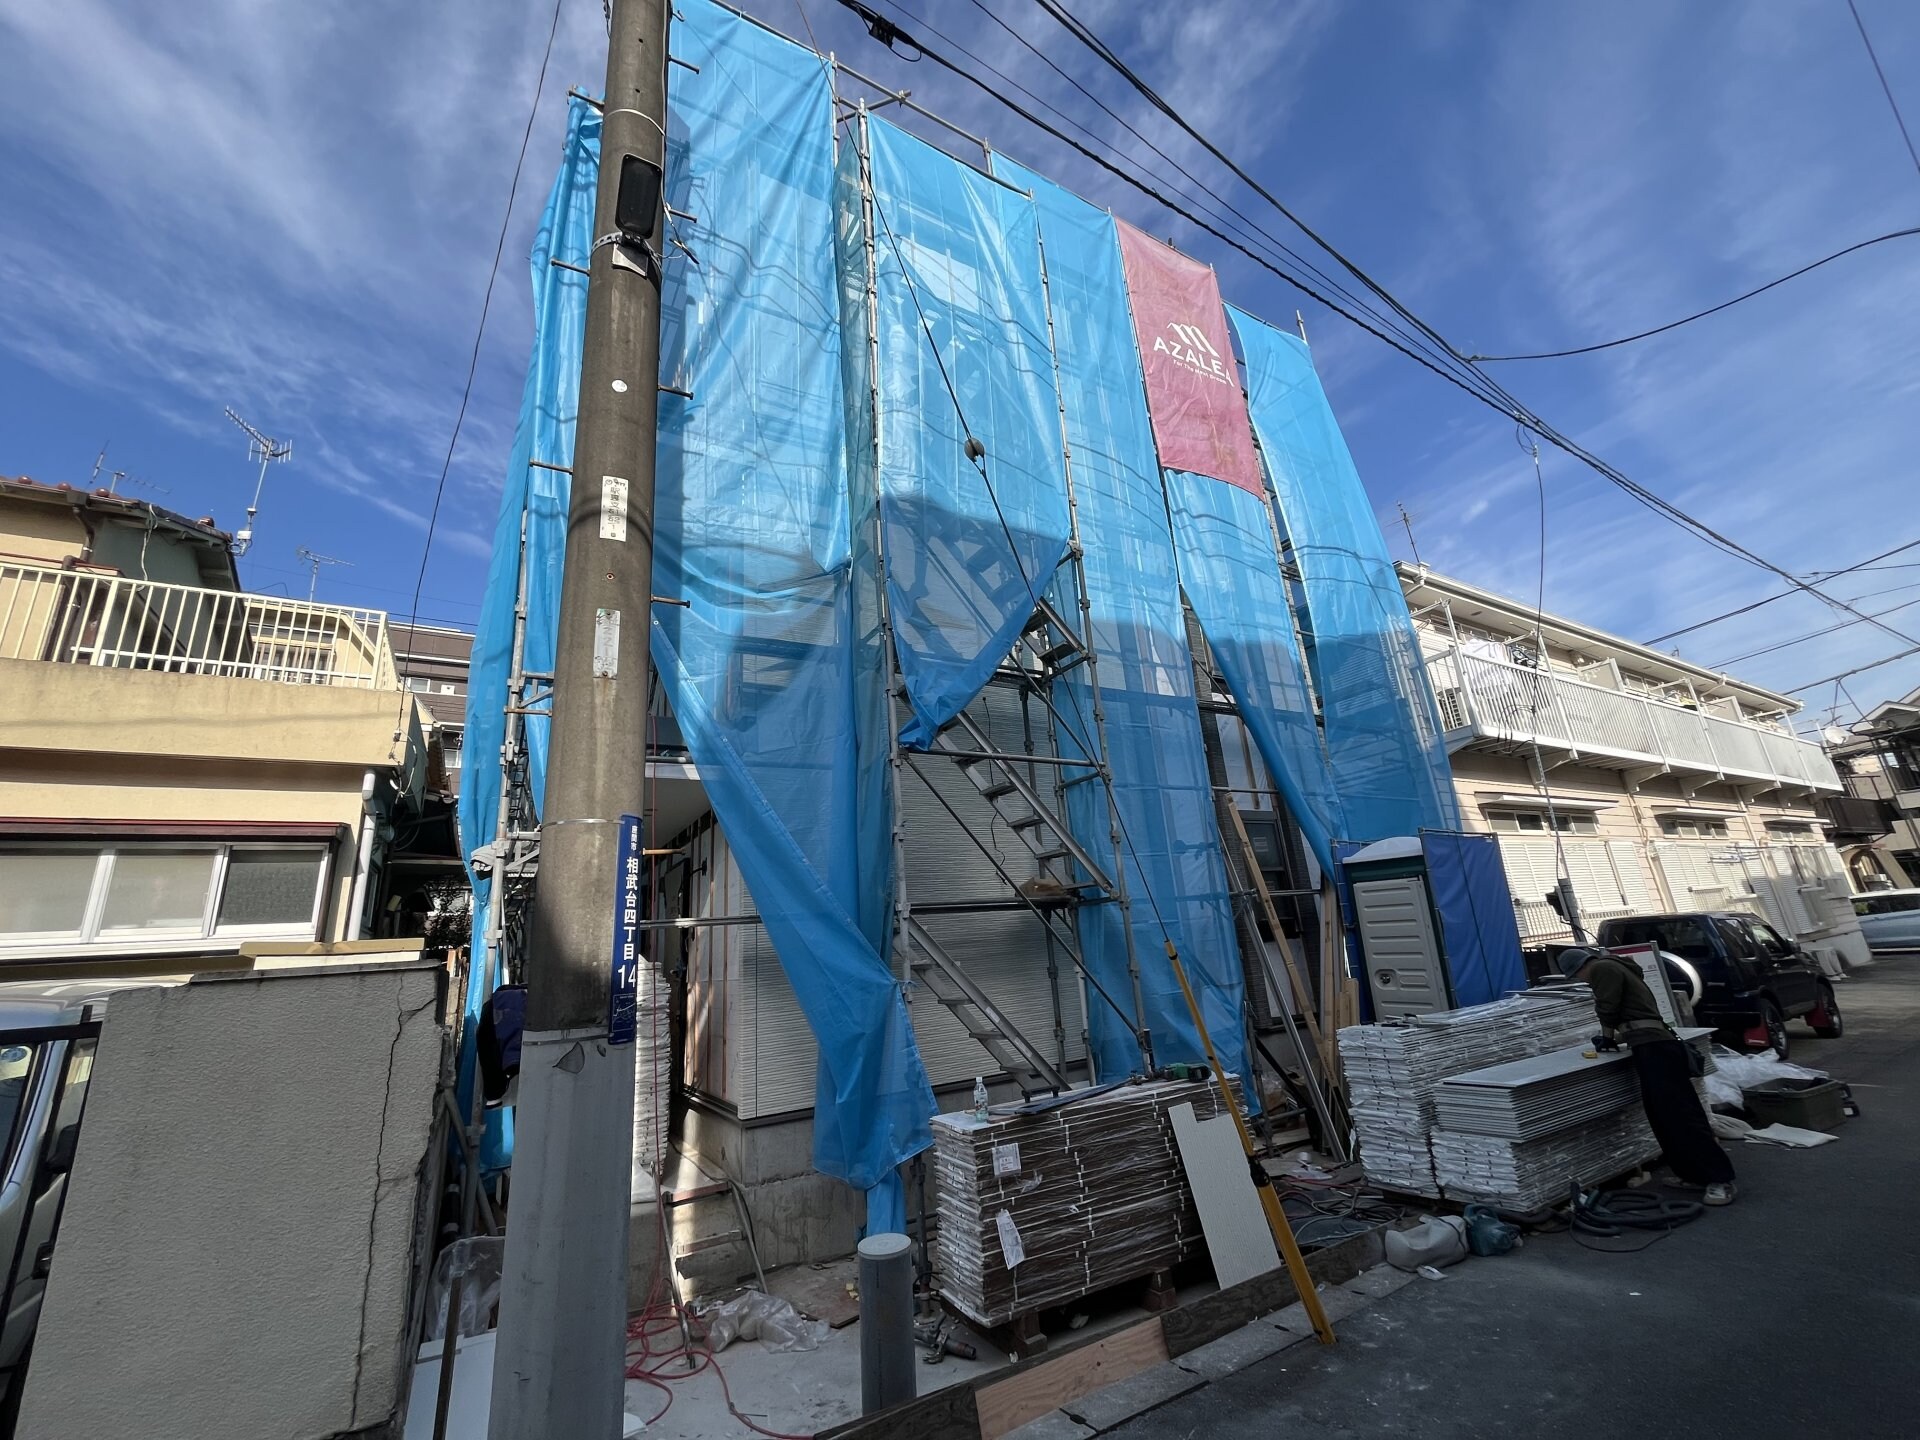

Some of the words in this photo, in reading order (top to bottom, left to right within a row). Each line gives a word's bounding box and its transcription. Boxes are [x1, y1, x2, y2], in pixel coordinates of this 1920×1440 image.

[1153, 336, 1235, 387] AZALEA
[623, 857, 639, 960] 相武台四丁目
[617, 964, 637, 989] 14
